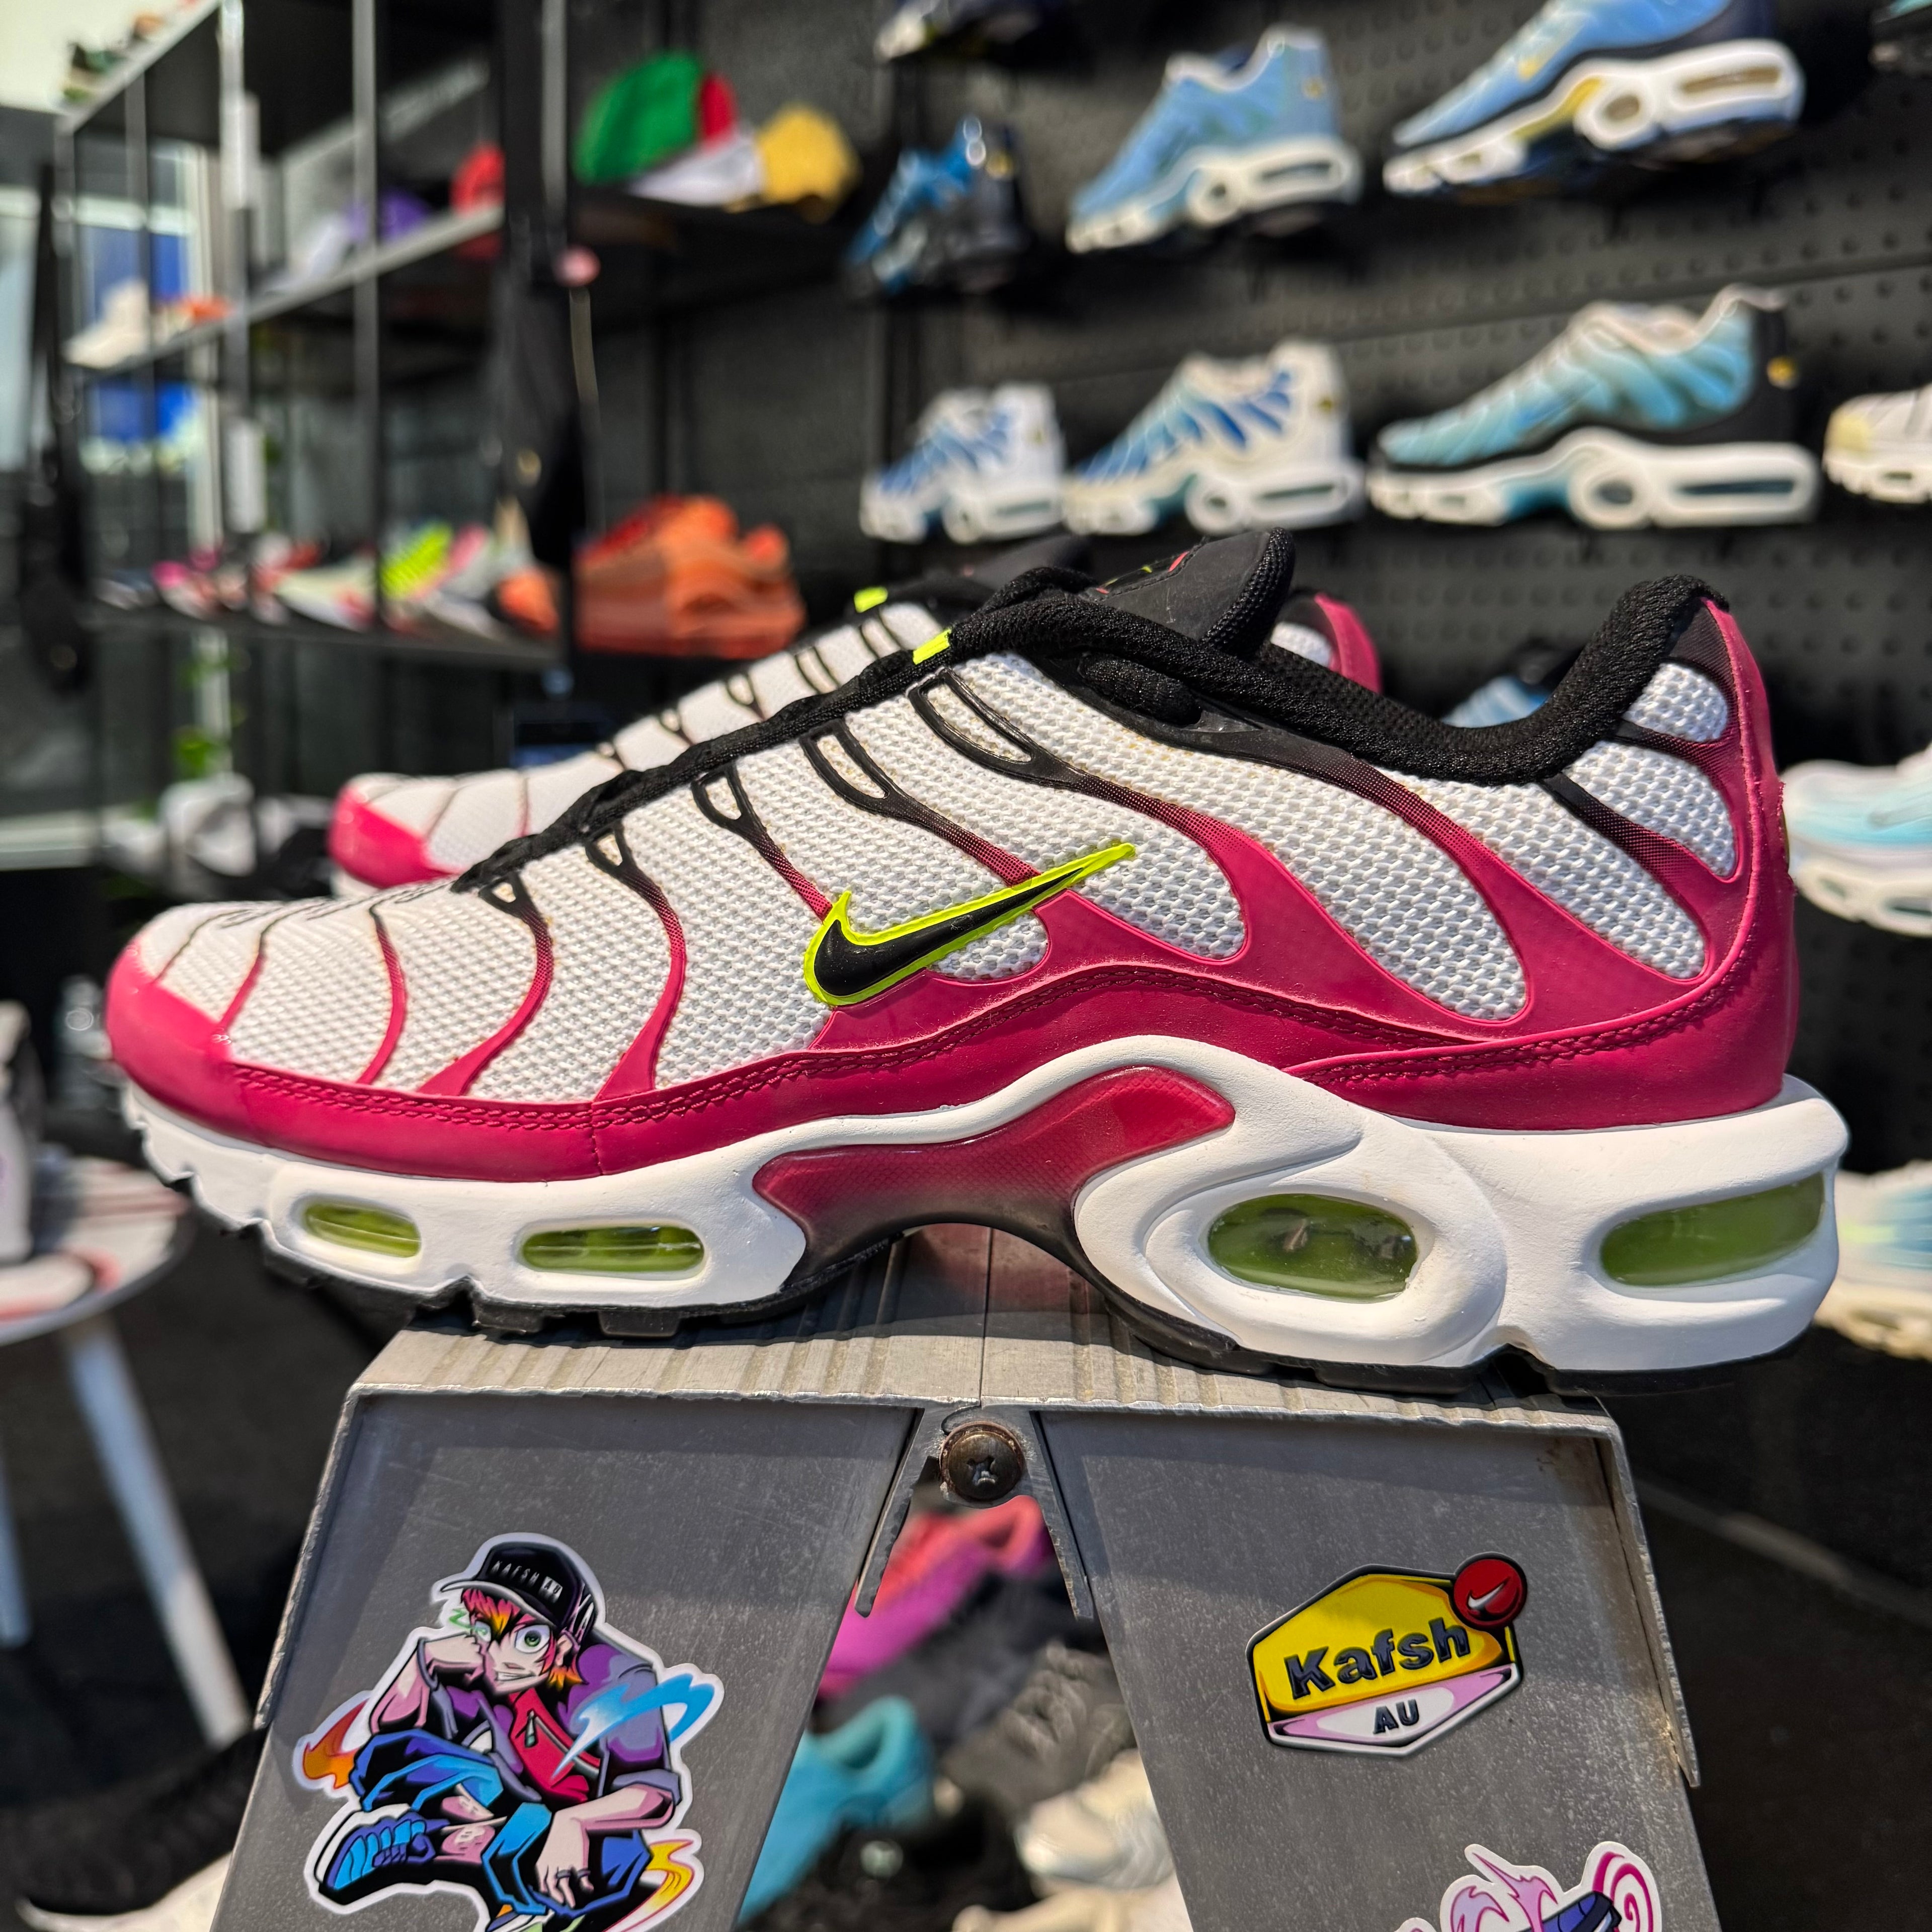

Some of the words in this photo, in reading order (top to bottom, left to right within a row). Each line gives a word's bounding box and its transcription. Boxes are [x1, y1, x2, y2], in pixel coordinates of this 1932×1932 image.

[543, 1579, 561, 1594] AU
[1283, 1617, 1471, 1700] Kafsh
[1373, 1699, 1420, 1734] AU
